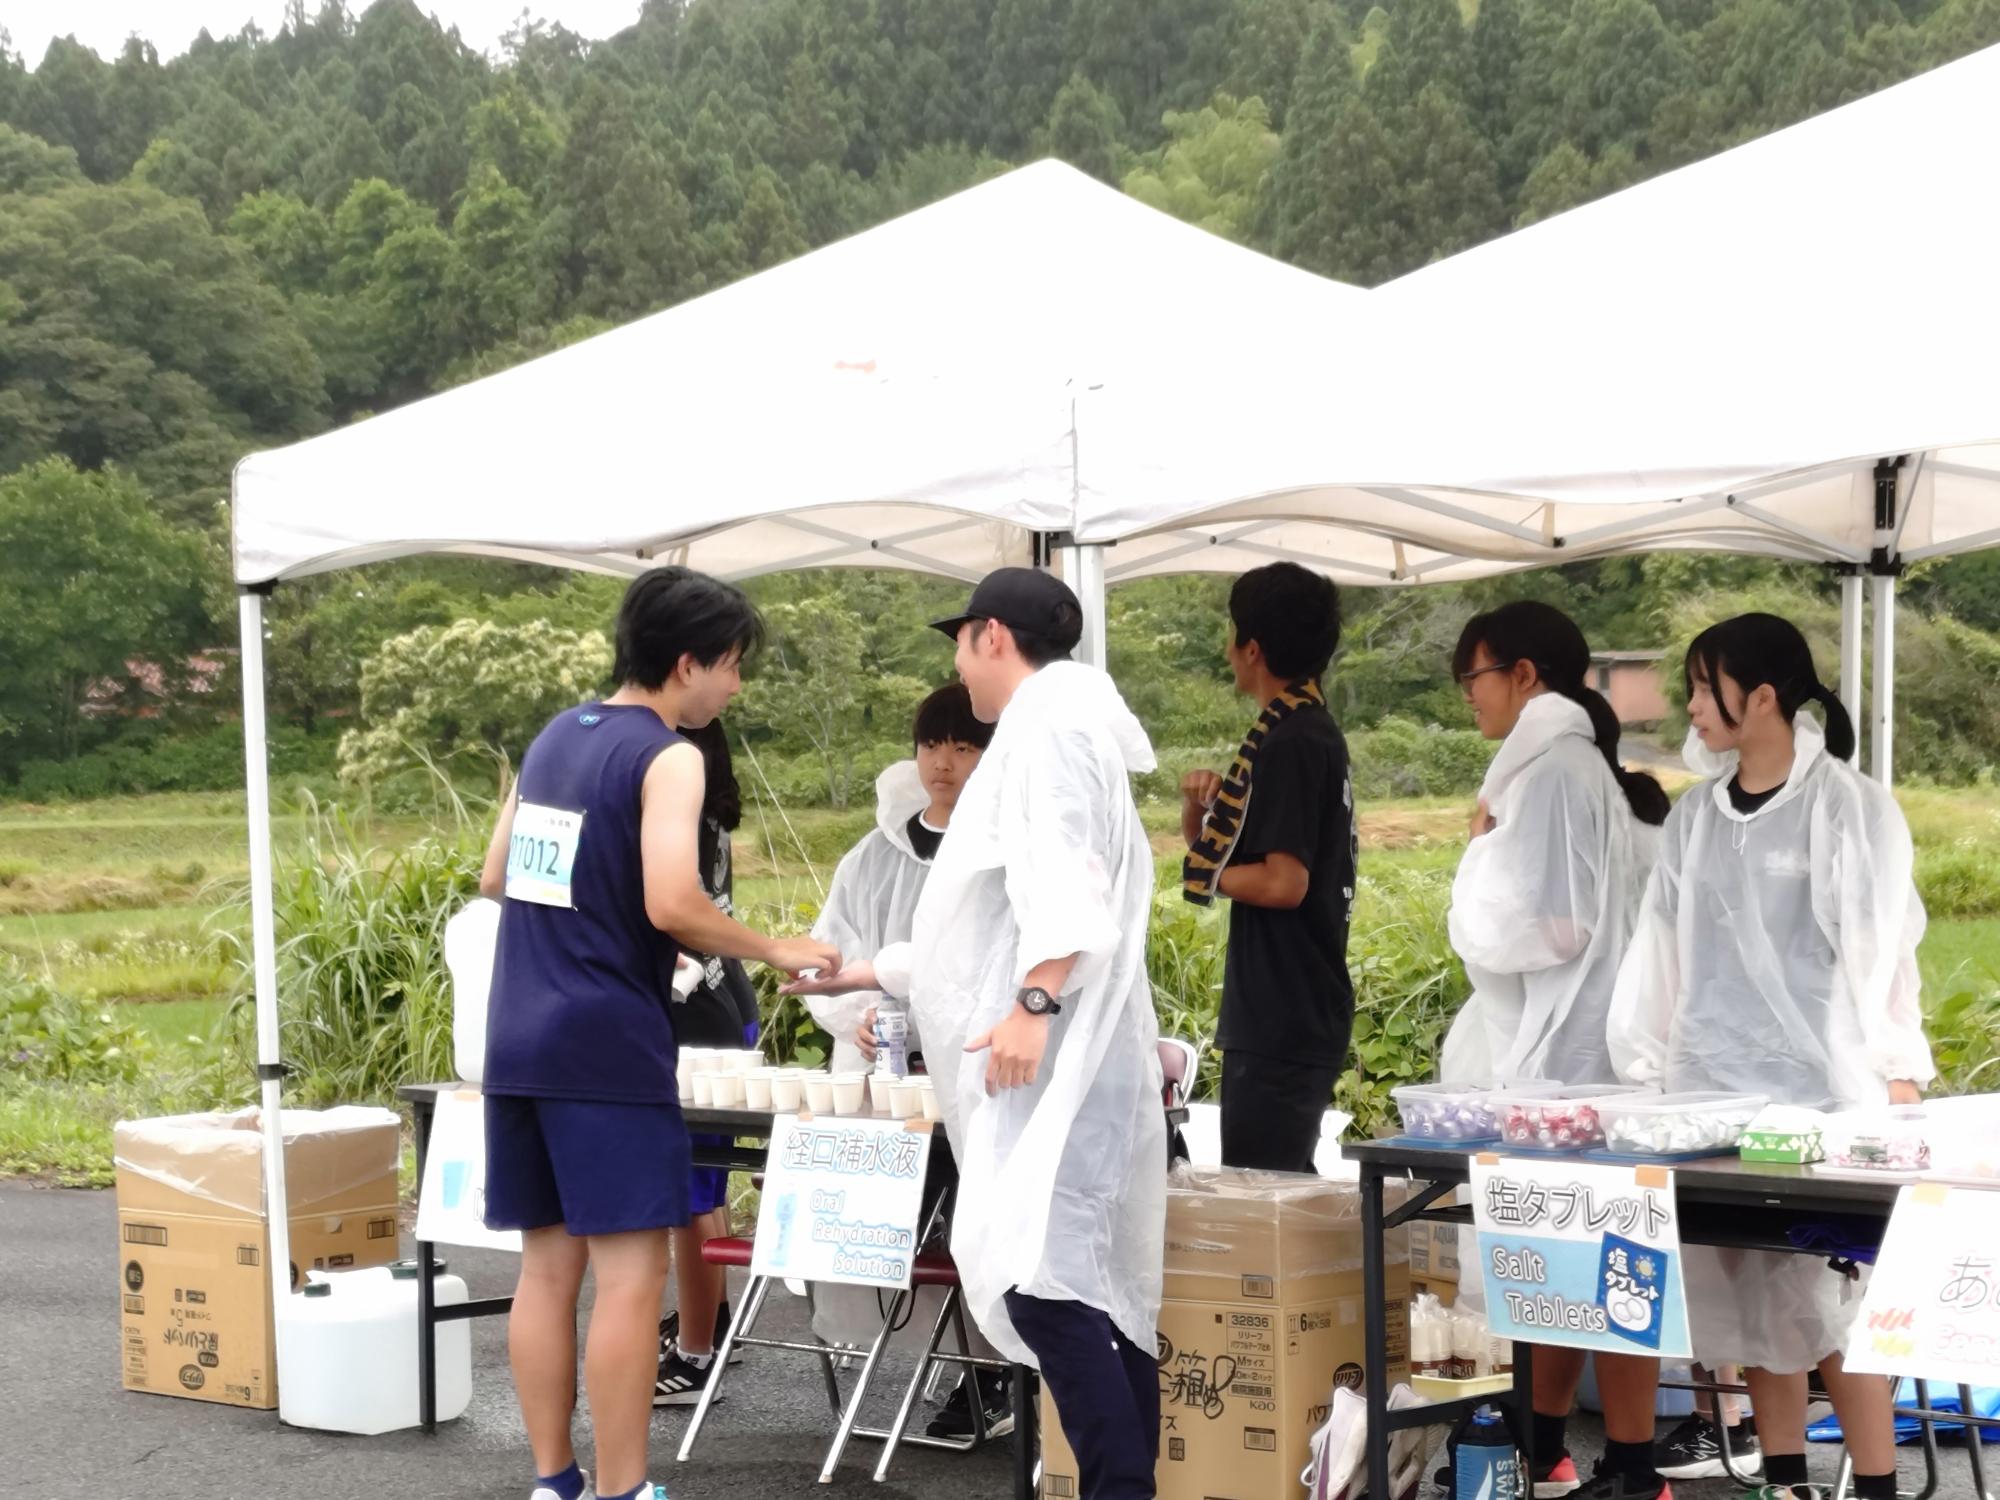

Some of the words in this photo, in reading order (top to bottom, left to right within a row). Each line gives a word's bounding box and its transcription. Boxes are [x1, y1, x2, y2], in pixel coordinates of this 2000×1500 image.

[785, 1129, 920, 1175] 経口補水液
[812, 1190, 845, 1212] Oral
[1487, 1178, 1668, 1235] 塩タブレット
[815, 1220, 911, 1248] Rehydration
[835, 1252, 905, 1278] Solution
[1493, 1249, 1545, 1282] Salt
[1939, 1255, 2000, 1309] あ
[1231, 1314, 1270, 1328] 32836
[1506, 1293, 1607, 1331] Tablets
